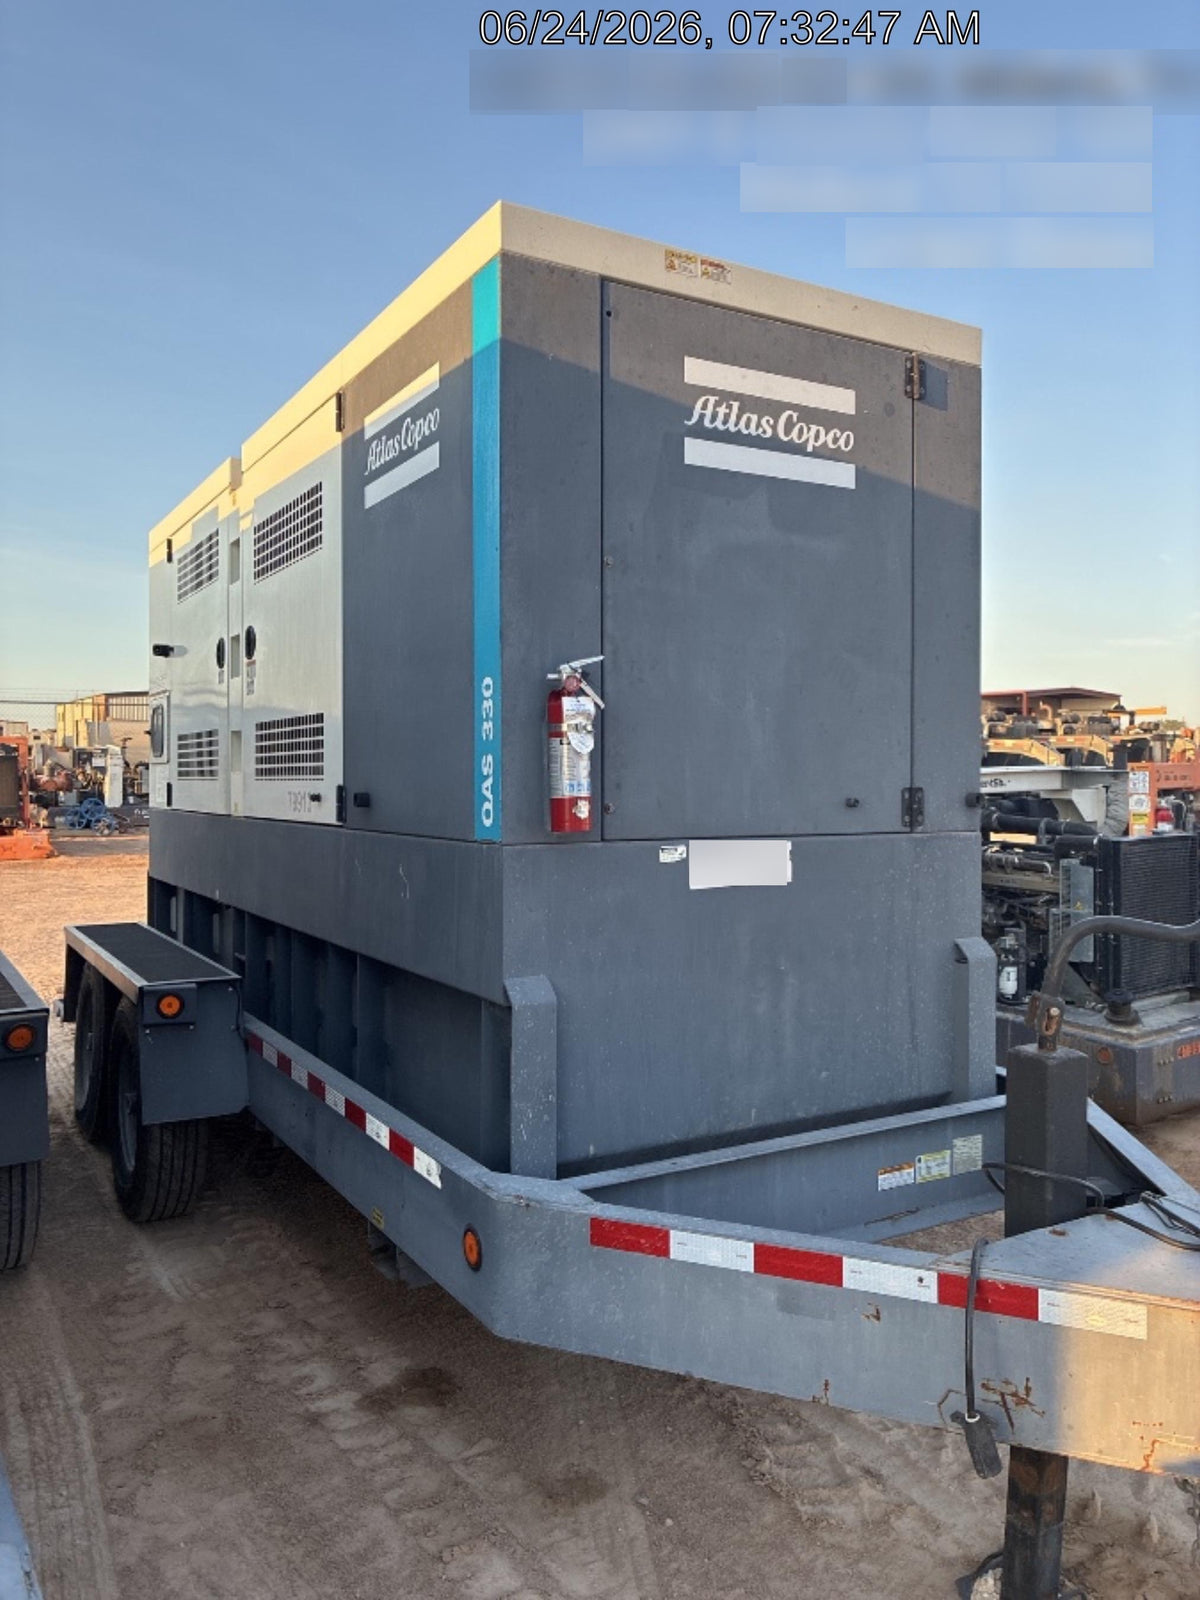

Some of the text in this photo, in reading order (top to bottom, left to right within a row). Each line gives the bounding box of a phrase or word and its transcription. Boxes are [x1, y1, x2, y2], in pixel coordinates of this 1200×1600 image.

[365, 409, 440, 475] Atlas Copco
[685, 395, 854, 452] Atlas Copco
[481, 676, 494, 828] QAS 330
